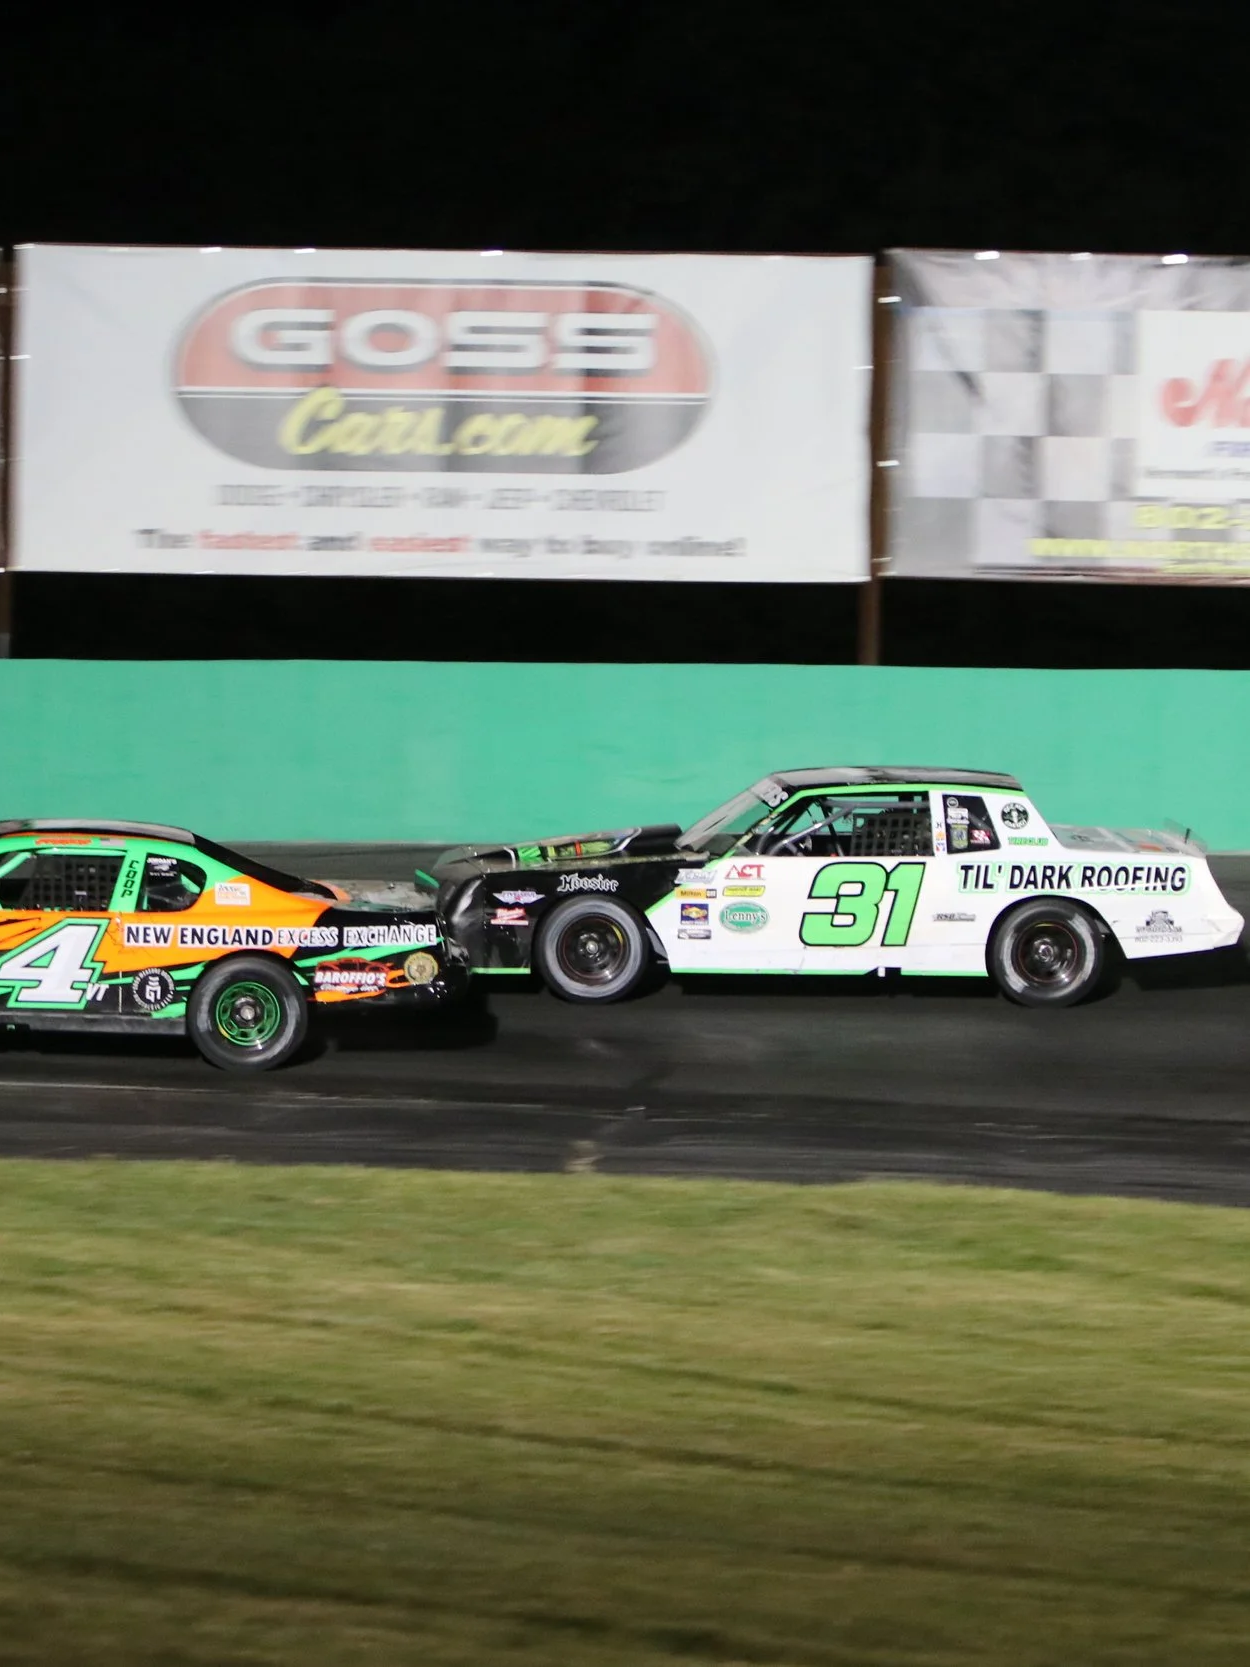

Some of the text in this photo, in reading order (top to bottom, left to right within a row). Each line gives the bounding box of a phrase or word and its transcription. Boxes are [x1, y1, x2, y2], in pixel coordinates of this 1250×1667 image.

[232, 308, 659, 373] GOSS
[279, 385, 600, 457] Cars.com
[136, 528, 190, 550] The
[307, 531, 360, 552] and
[557, 873, 619, 892] Hoosier
[725, 864, 765, 880] ACT
[960, 864, 1187, 892] TIL' DARK ROOFING
[799, 861, 927, 946] 31
[725, 910, 766, 924] Lenny's
[126, 925, 437, 947] NEW ENGLAND EXCESS EXCHANGE
[315, 971, 387, 986] BAROFFIO'S
[85, 983, 110, 1001] VT
